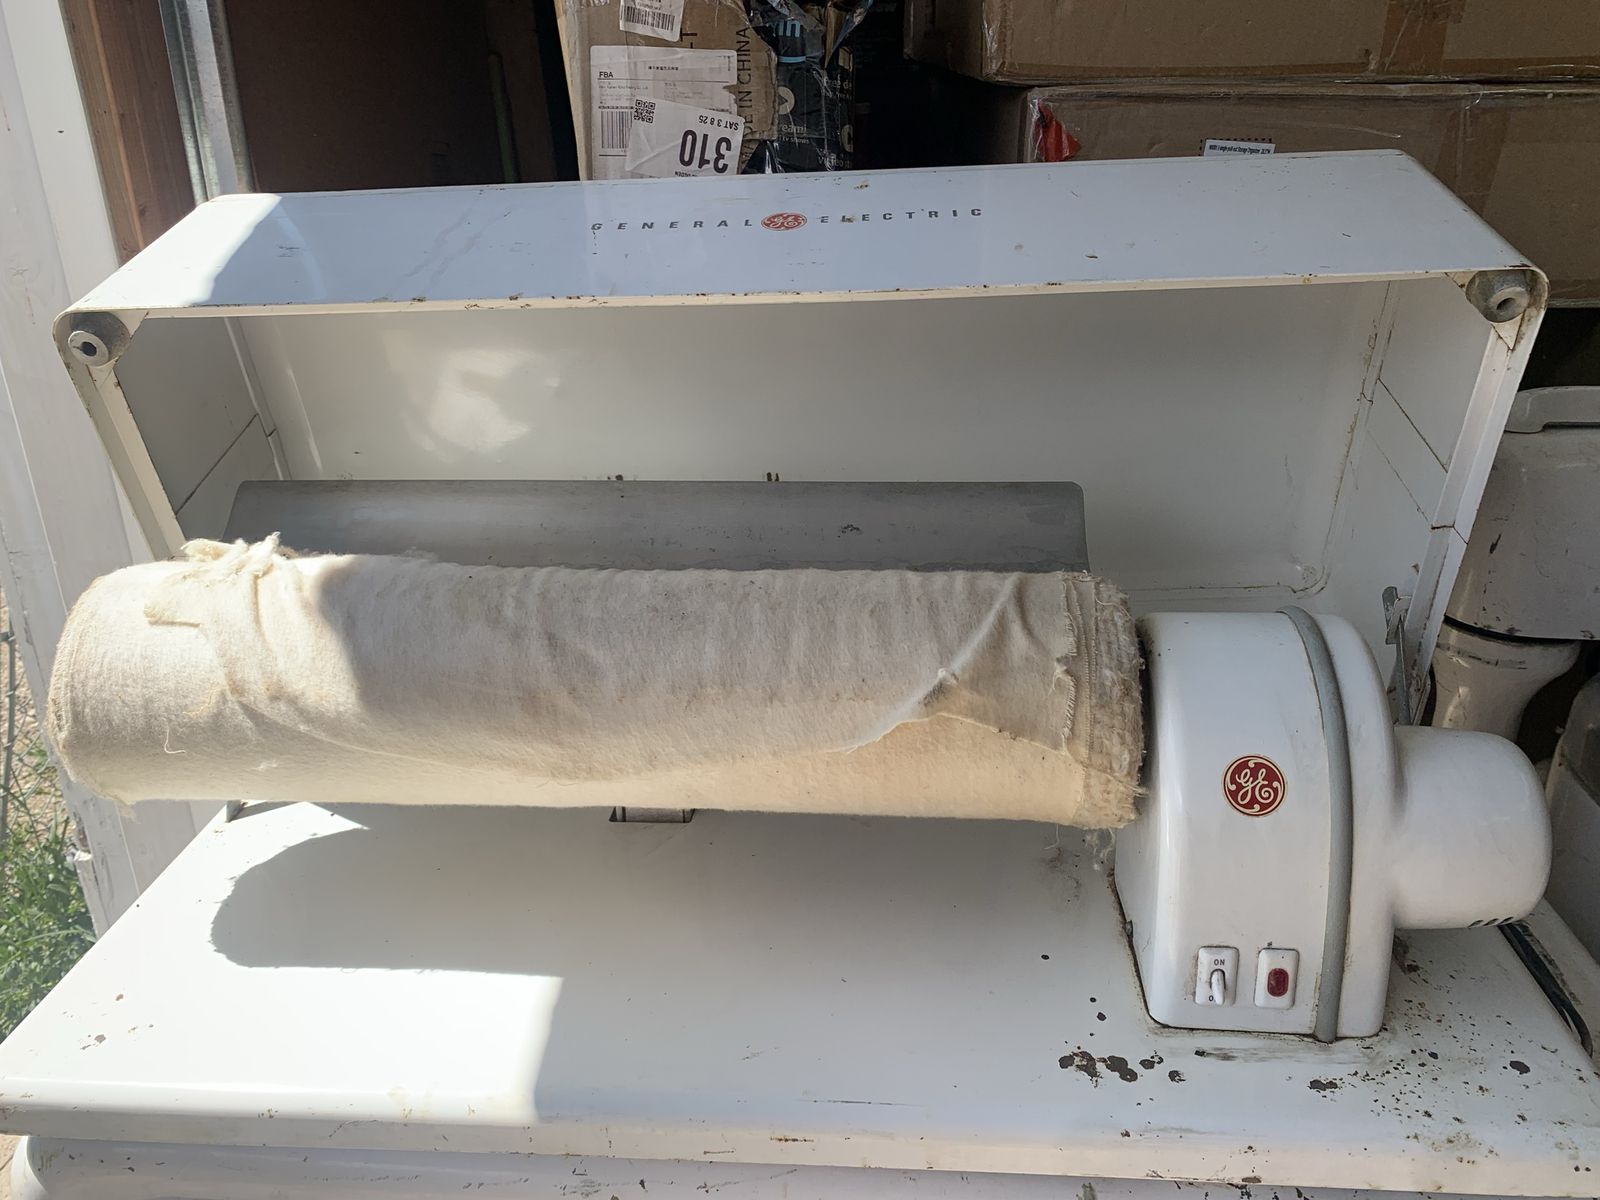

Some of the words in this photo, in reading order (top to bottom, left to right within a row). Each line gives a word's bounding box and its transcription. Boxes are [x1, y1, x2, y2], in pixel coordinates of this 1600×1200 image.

[736, 27, 752, 85] CHINA
[738, 90, 752, 108] IN
[698, 115, 709, 125] 25
[709, 117, 716, 126] 8
[716, 118, 723, 128] 3
[723, 120, 740, 131] SAT
[679, 129, 732, 174] 310
[591, 218, 753, 231] GENERAL
[820, 207, 982, 224] ELECTRIC
[1214, 958, 1225, 966] ON
